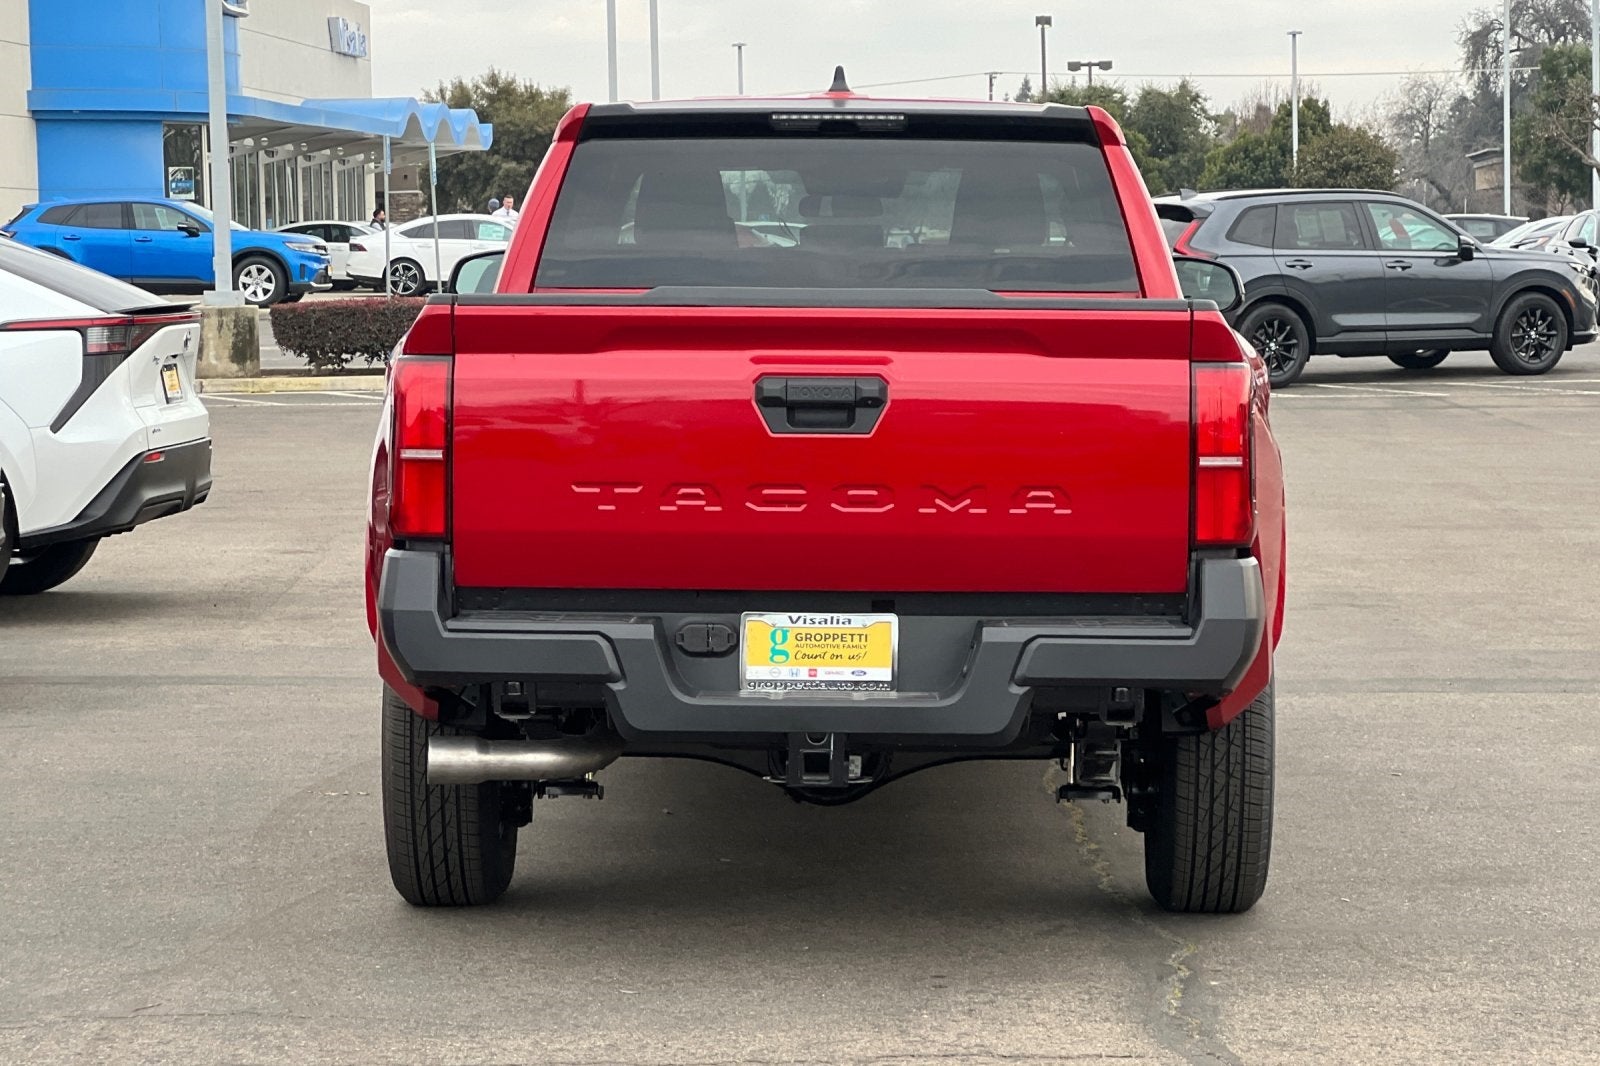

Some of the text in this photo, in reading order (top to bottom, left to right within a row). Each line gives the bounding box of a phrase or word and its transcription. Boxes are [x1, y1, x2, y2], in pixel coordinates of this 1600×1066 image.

[791, 385, 853, 400] TOYOTA
[571, 481, 1073, 515] TACOMA
[788, 615, 852, 626] Visalia
[794, 632, 868, 643] GROPPETTI
[794, 649, 868, 661] Count on us!
